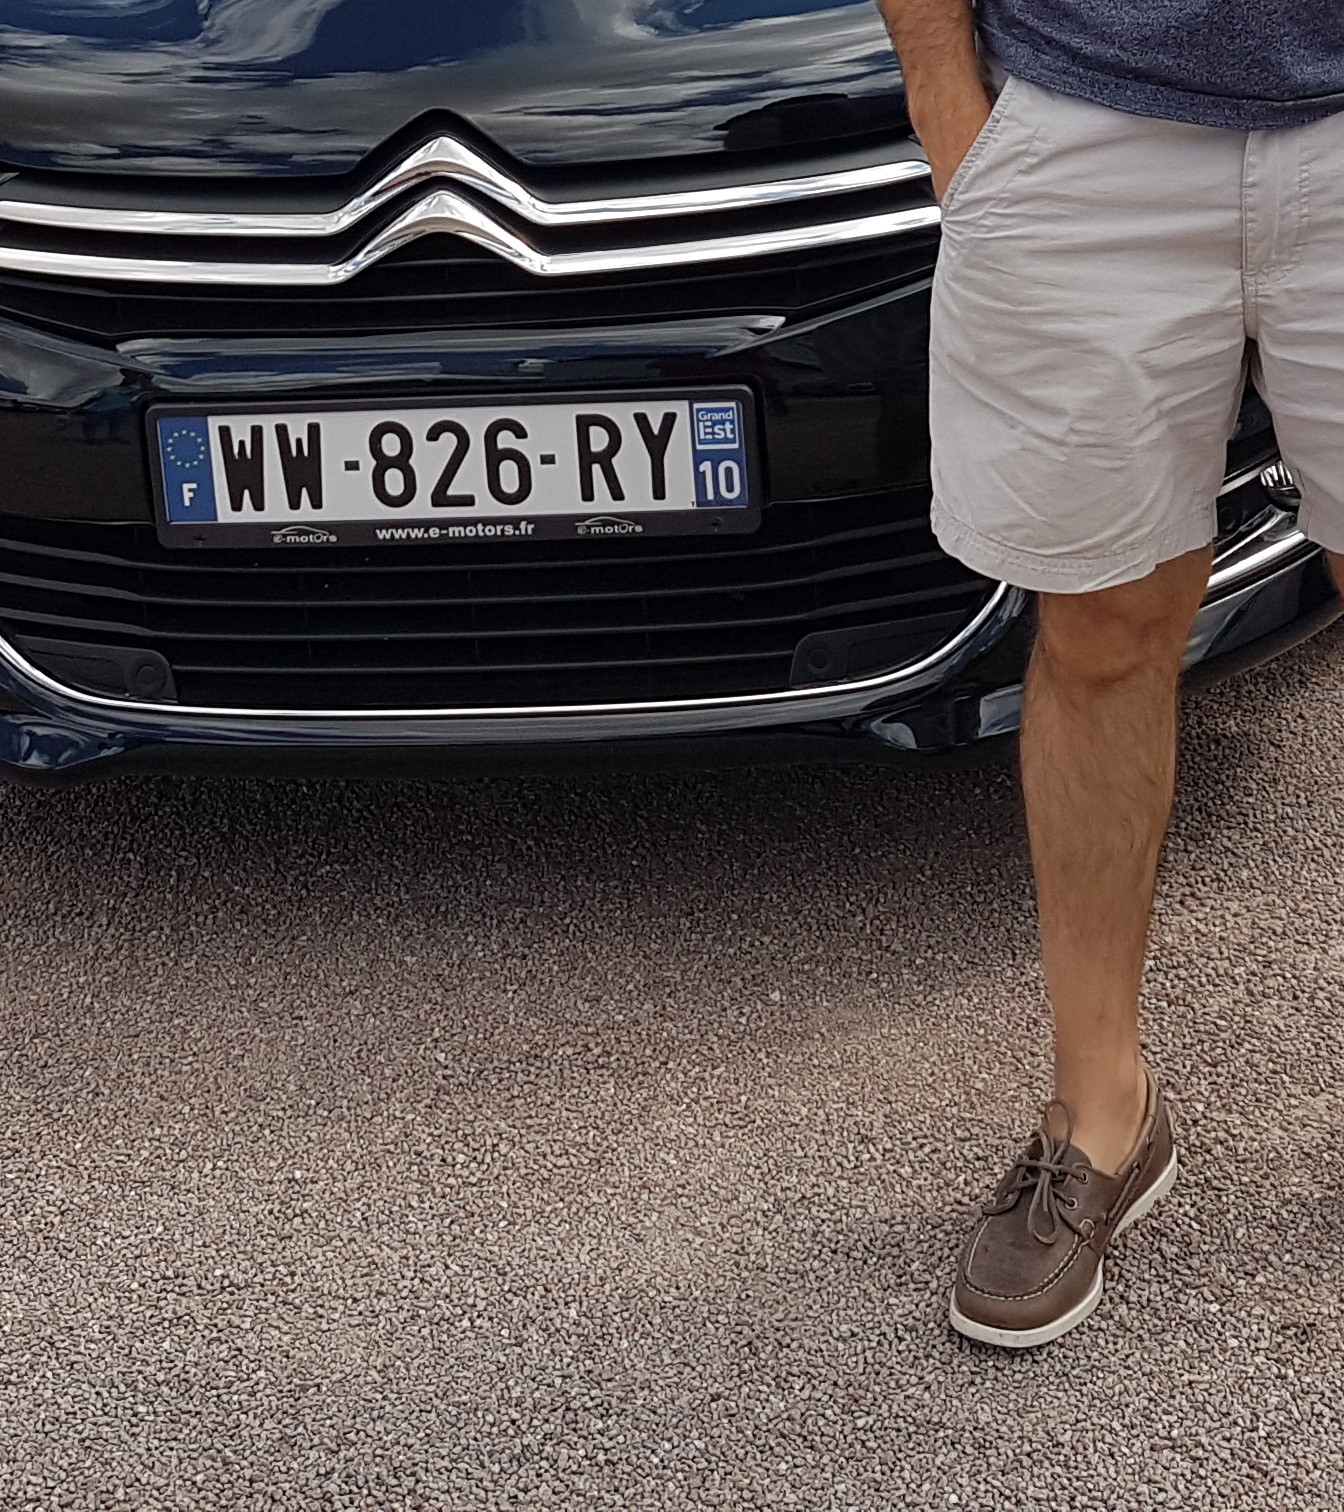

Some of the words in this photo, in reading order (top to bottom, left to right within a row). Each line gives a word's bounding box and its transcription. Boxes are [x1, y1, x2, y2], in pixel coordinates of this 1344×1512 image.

[697, 410, 734, 421] Grand
[698, 421, 735, 440] Est
[218, 411, 678, 513] WW-826-RY
[698, 459, 742, 502] 10
[182, 482, 198, 507] F
[375, 521, 535, 540] www.e-motors.fr
